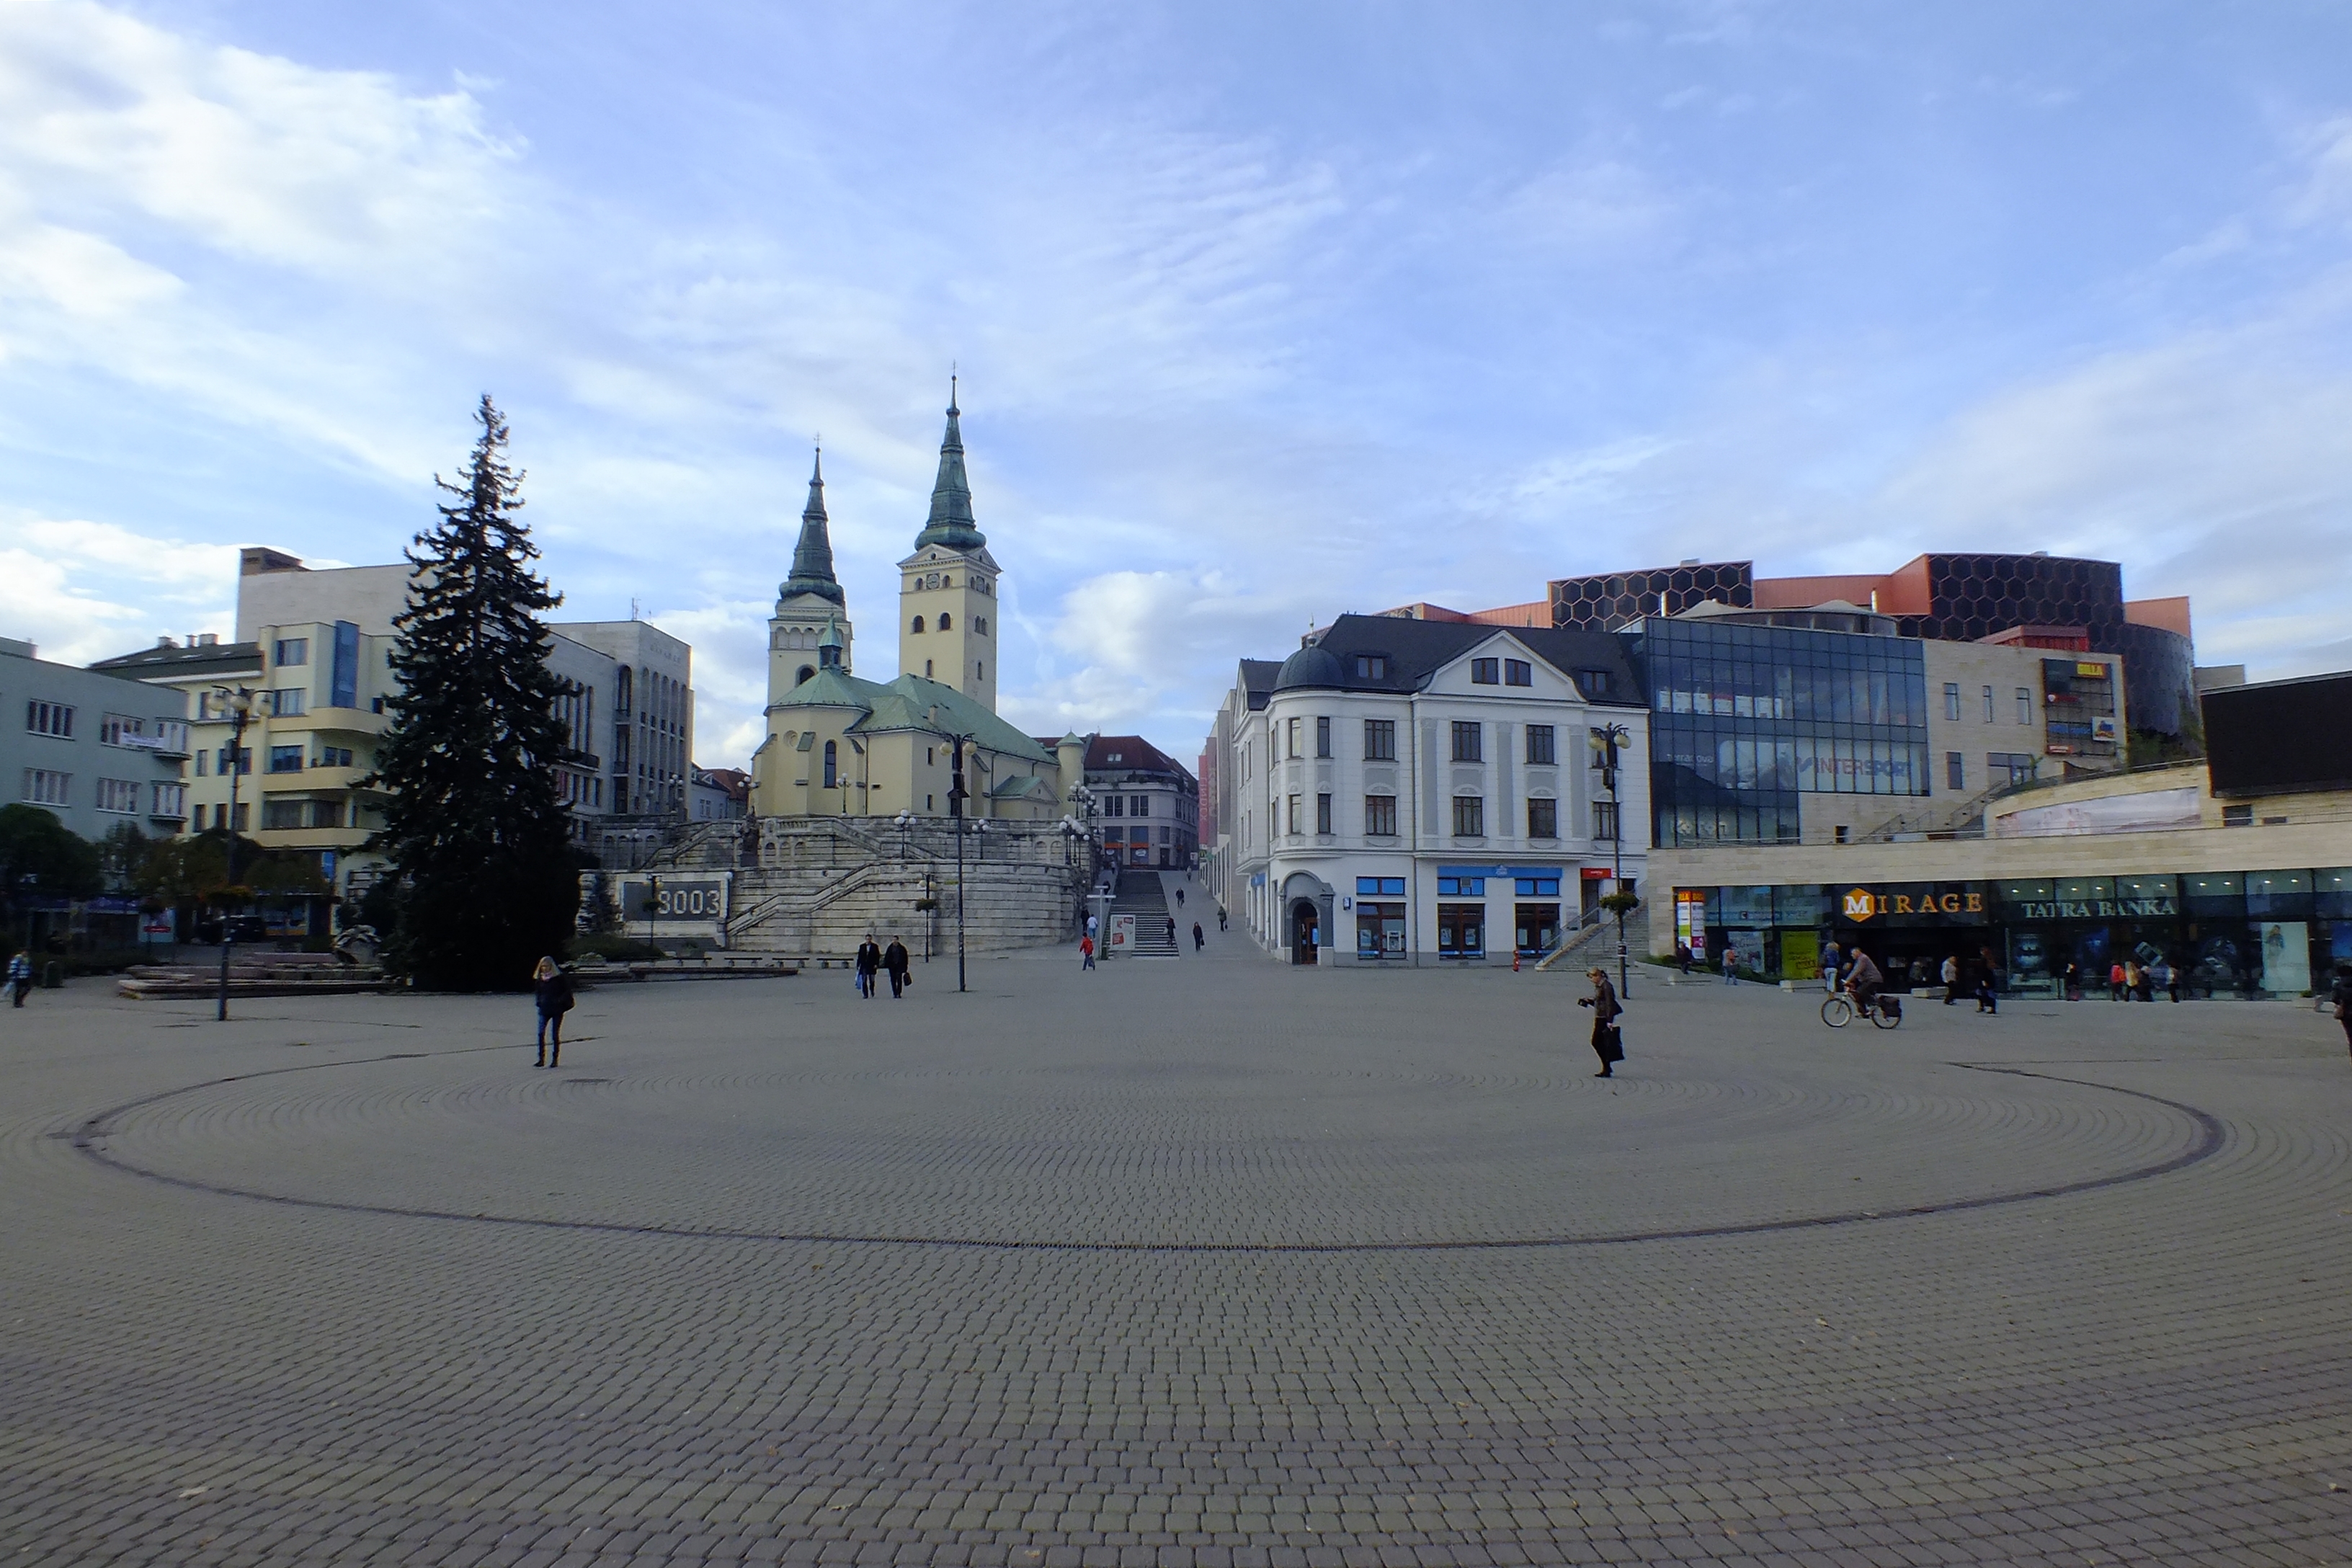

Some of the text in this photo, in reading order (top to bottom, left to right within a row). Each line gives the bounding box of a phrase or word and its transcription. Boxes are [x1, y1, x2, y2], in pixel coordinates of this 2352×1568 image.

[1845, 894, 1982, 914] MIRAGE
[2021, 899, 2176, 918] TATRA BANKA
